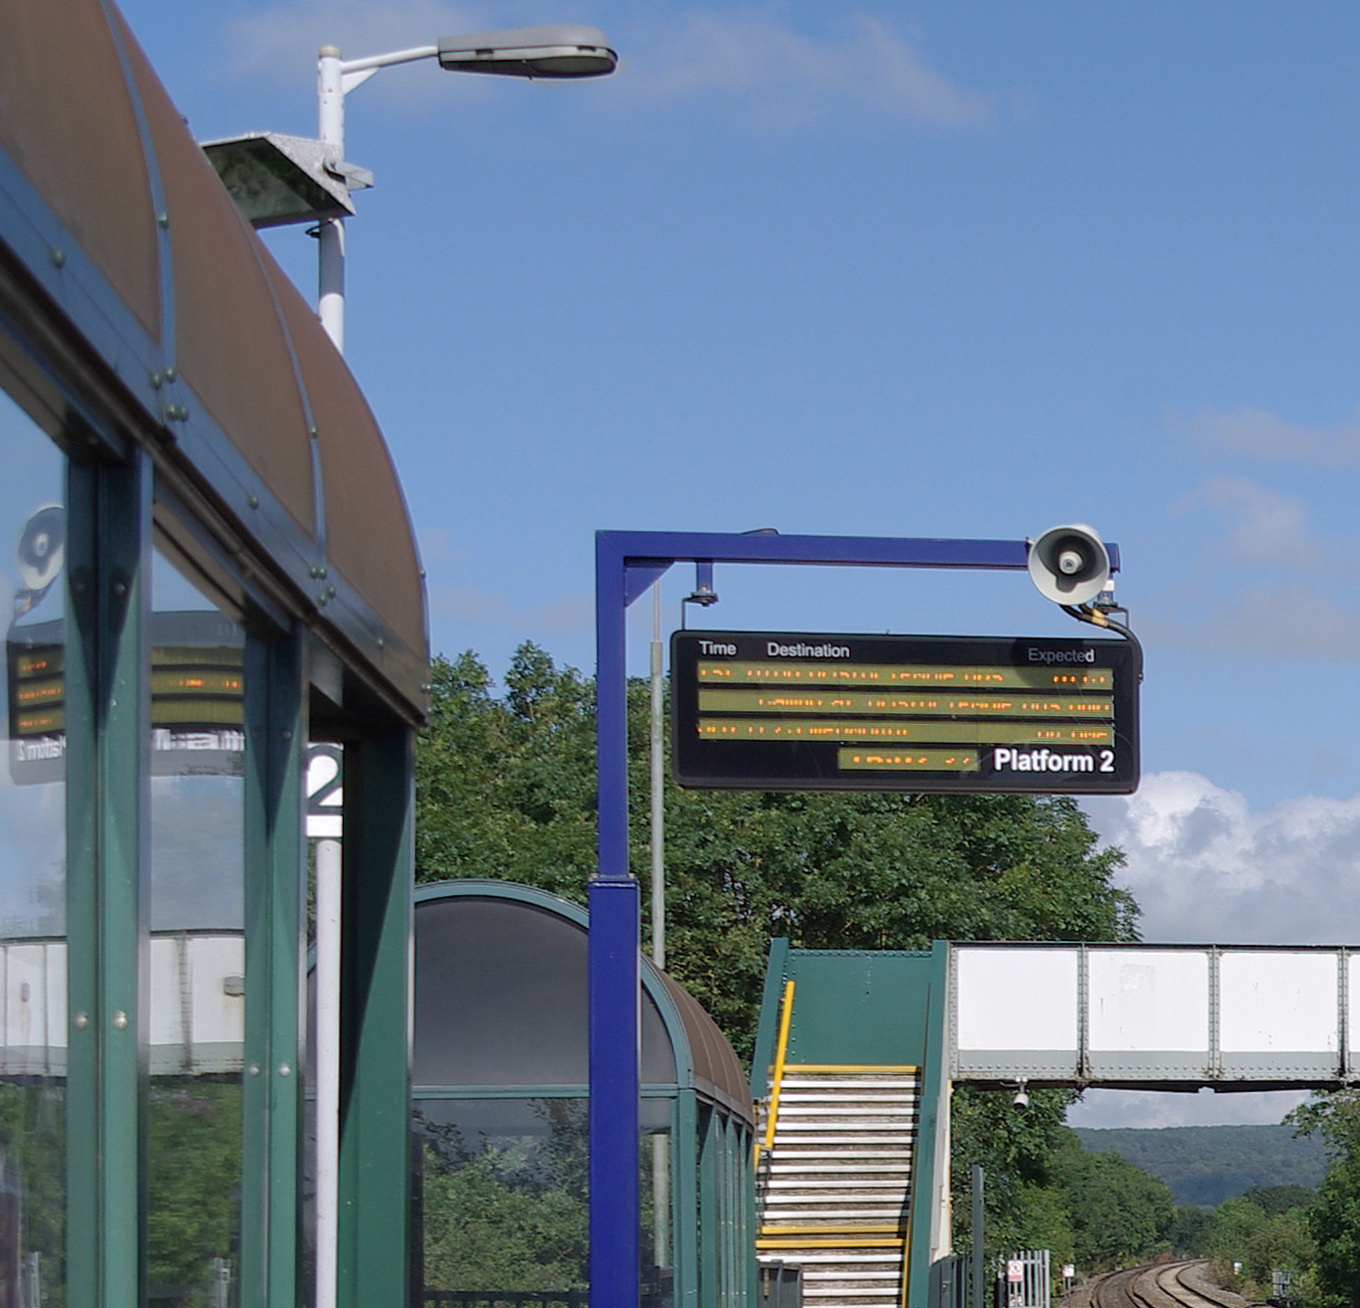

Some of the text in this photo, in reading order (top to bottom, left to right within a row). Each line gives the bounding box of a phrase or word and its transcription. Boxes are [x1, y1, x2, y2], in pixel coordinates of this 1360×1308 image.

[699, 641, 737, 656] Time
[767, 642, 850, 658] Destination
[1028, 648, 1095, 664] Expected
[994, 748, 1115, 772] Platform 2
[304, 744, 343, 815] 2
